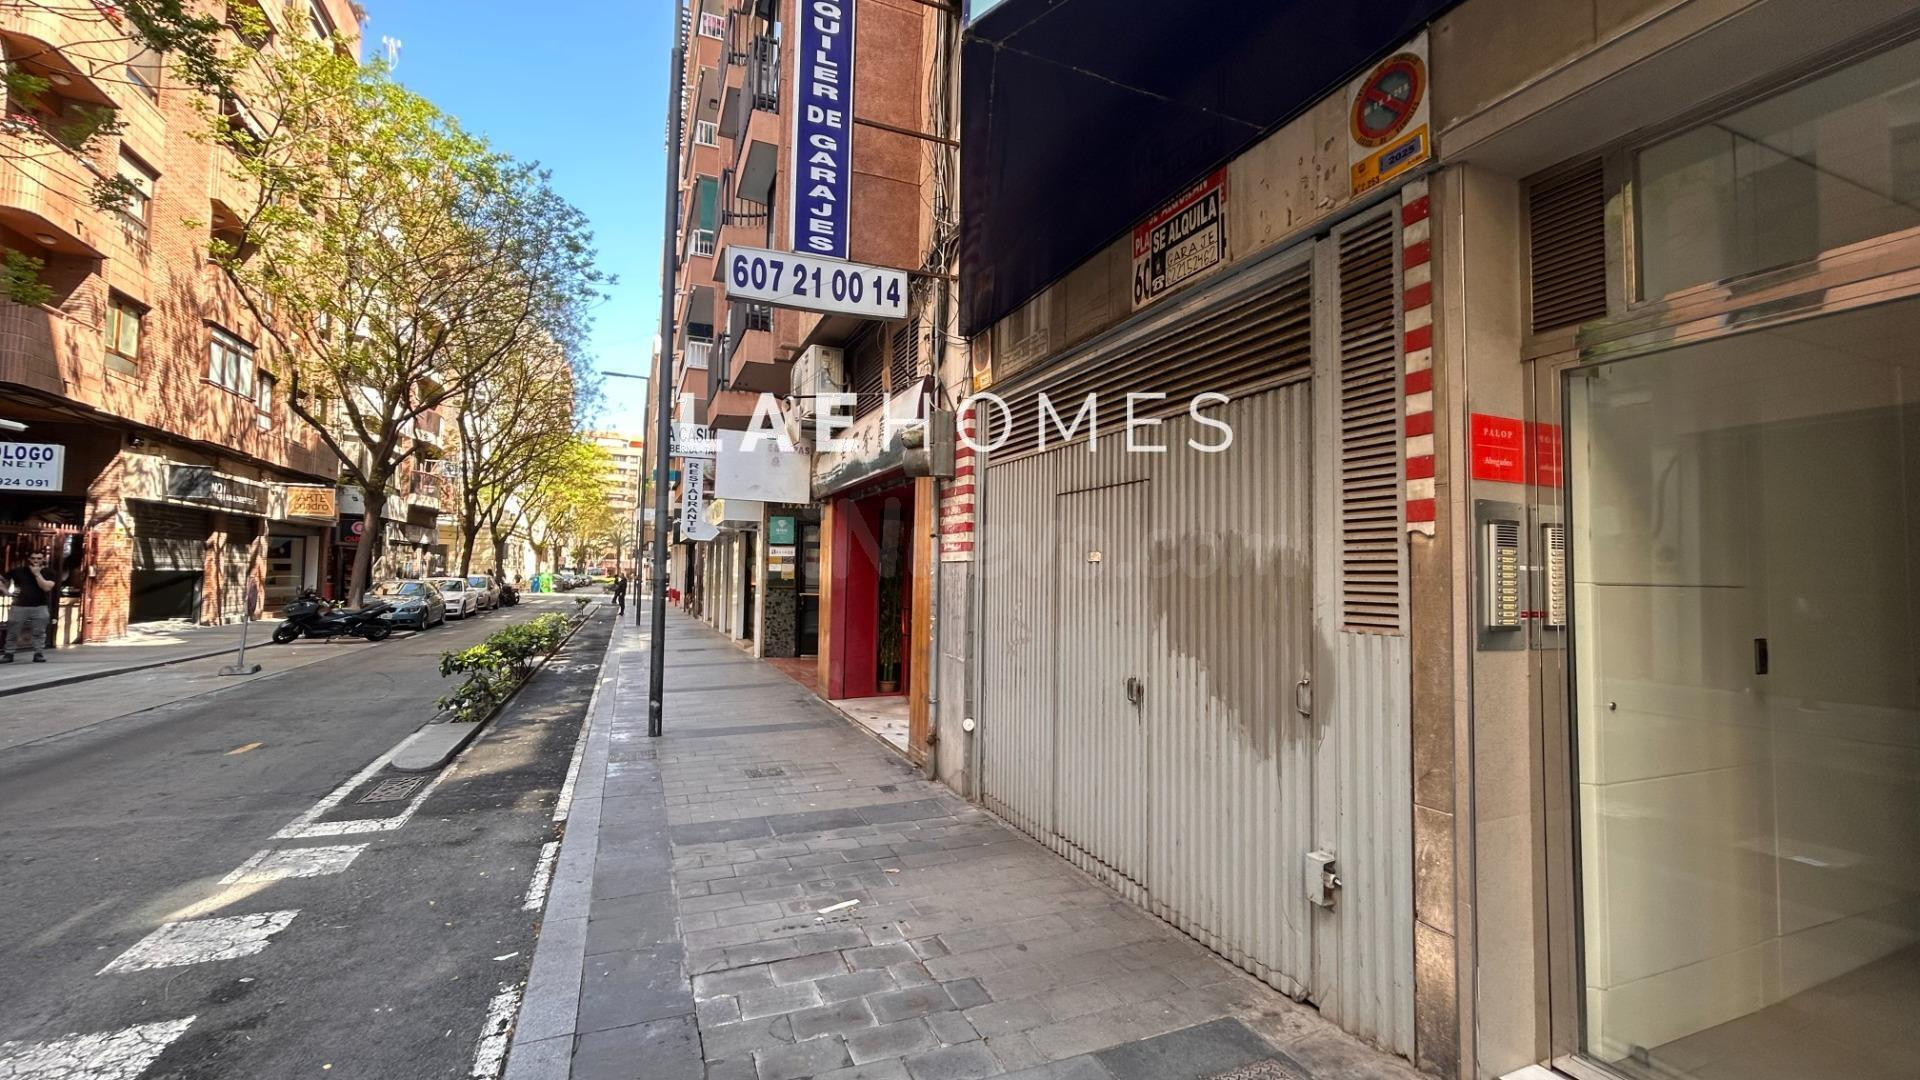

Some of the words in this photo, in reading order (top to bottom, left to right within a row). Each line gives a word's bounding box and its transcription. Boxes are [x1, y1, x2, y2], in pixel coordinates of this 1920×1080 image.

[812, 0, 842, 101] QUILER
[807, 106, 842, 129] DE
[1388, 144, 1415, 166] 2025
[808, 134, 838, 251] GARAJES
[1152, 227, 1166, 253] SE
[1168, 195, 1217, 245] ALQUILA
[733, 254, 784, 292] 607
[793, 263, 821, 298] 21
[832, 269, 864, 304] 00
[872, 275, 901, 307] 14
[1483, 427, 1513, 438] PALOP
[0, 445, 54, 461] LOGO
[25, 479, 49, 487] 091
[296, 493, 327, 503] ARTE
[687, 462, 699, 534] RESTAURANTE
